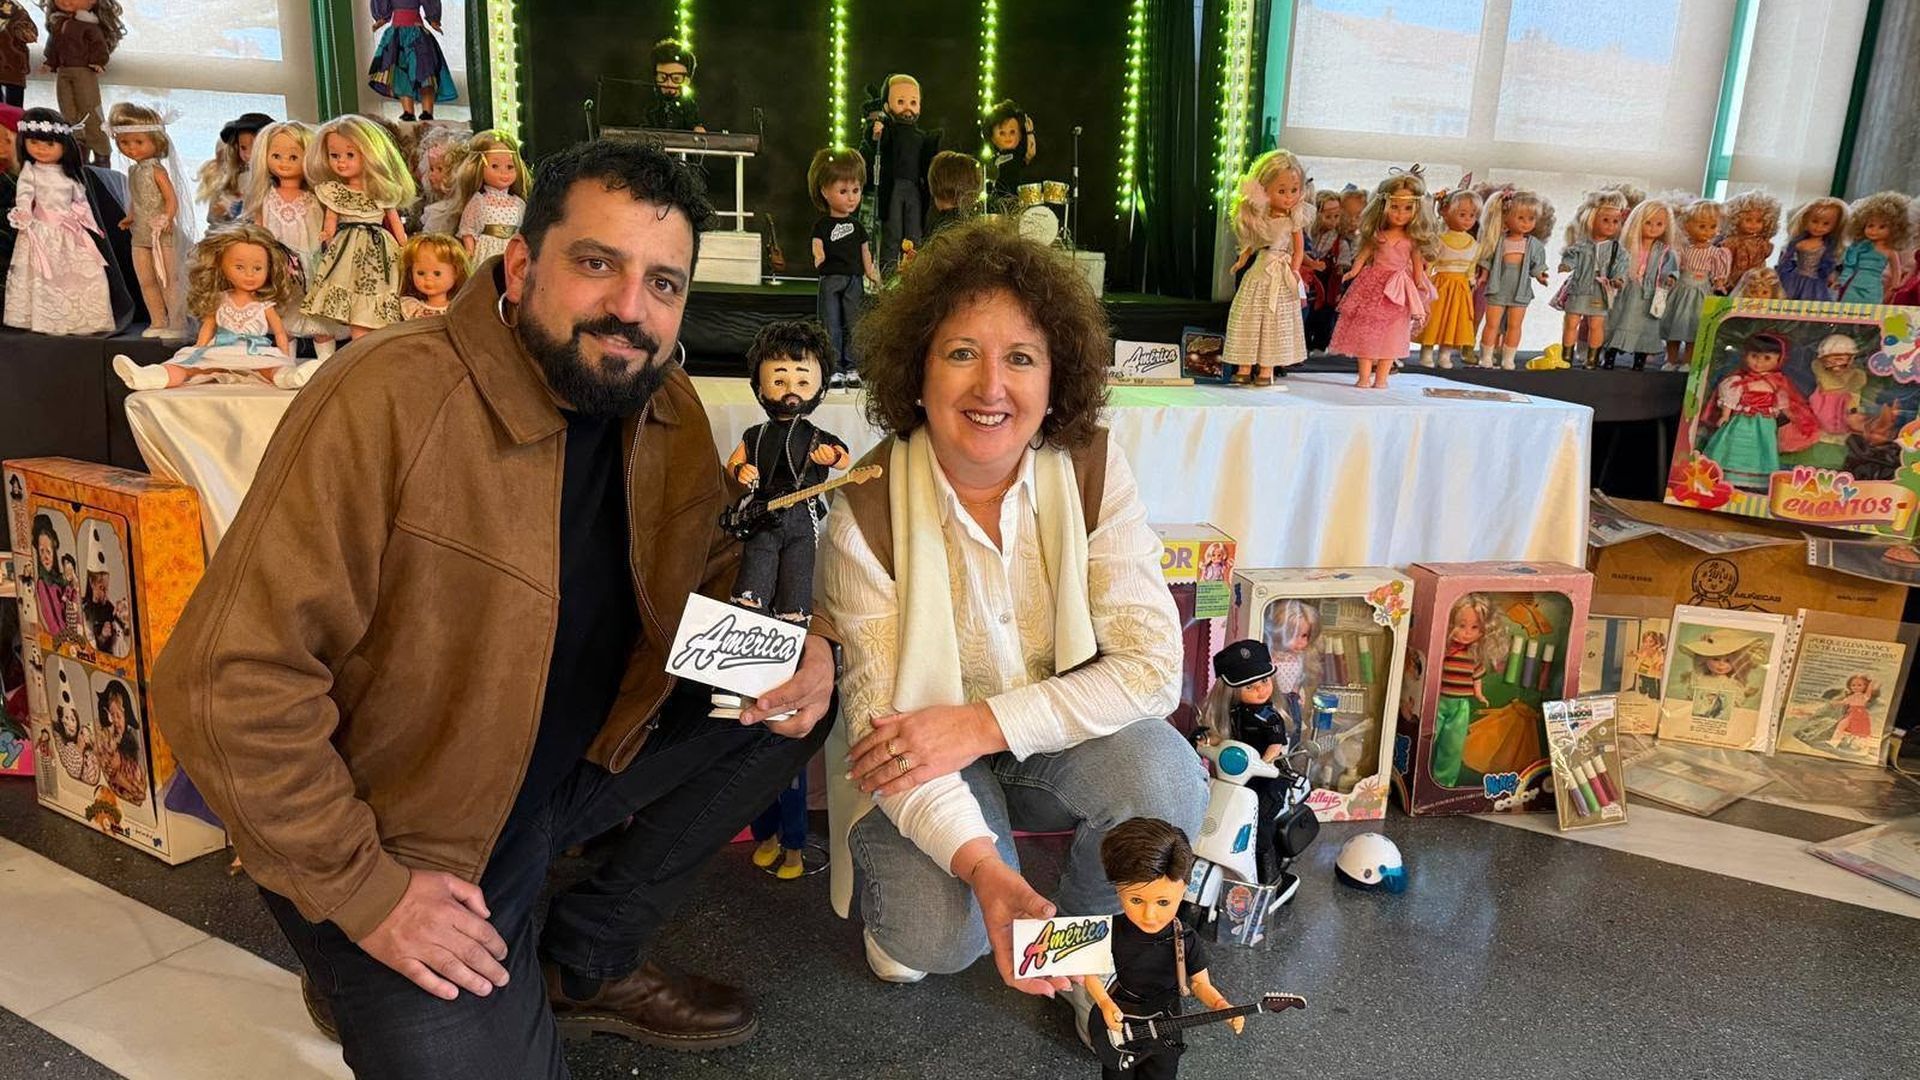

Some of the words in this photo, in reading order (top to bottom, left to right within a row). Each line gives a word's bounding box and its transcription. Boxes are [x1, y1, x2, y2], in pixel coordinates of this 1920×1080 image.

[1793, 468, 1858, 500] NANCY
[671, 613, 797, 670] América
[1019, 919, 1109, 976] América
